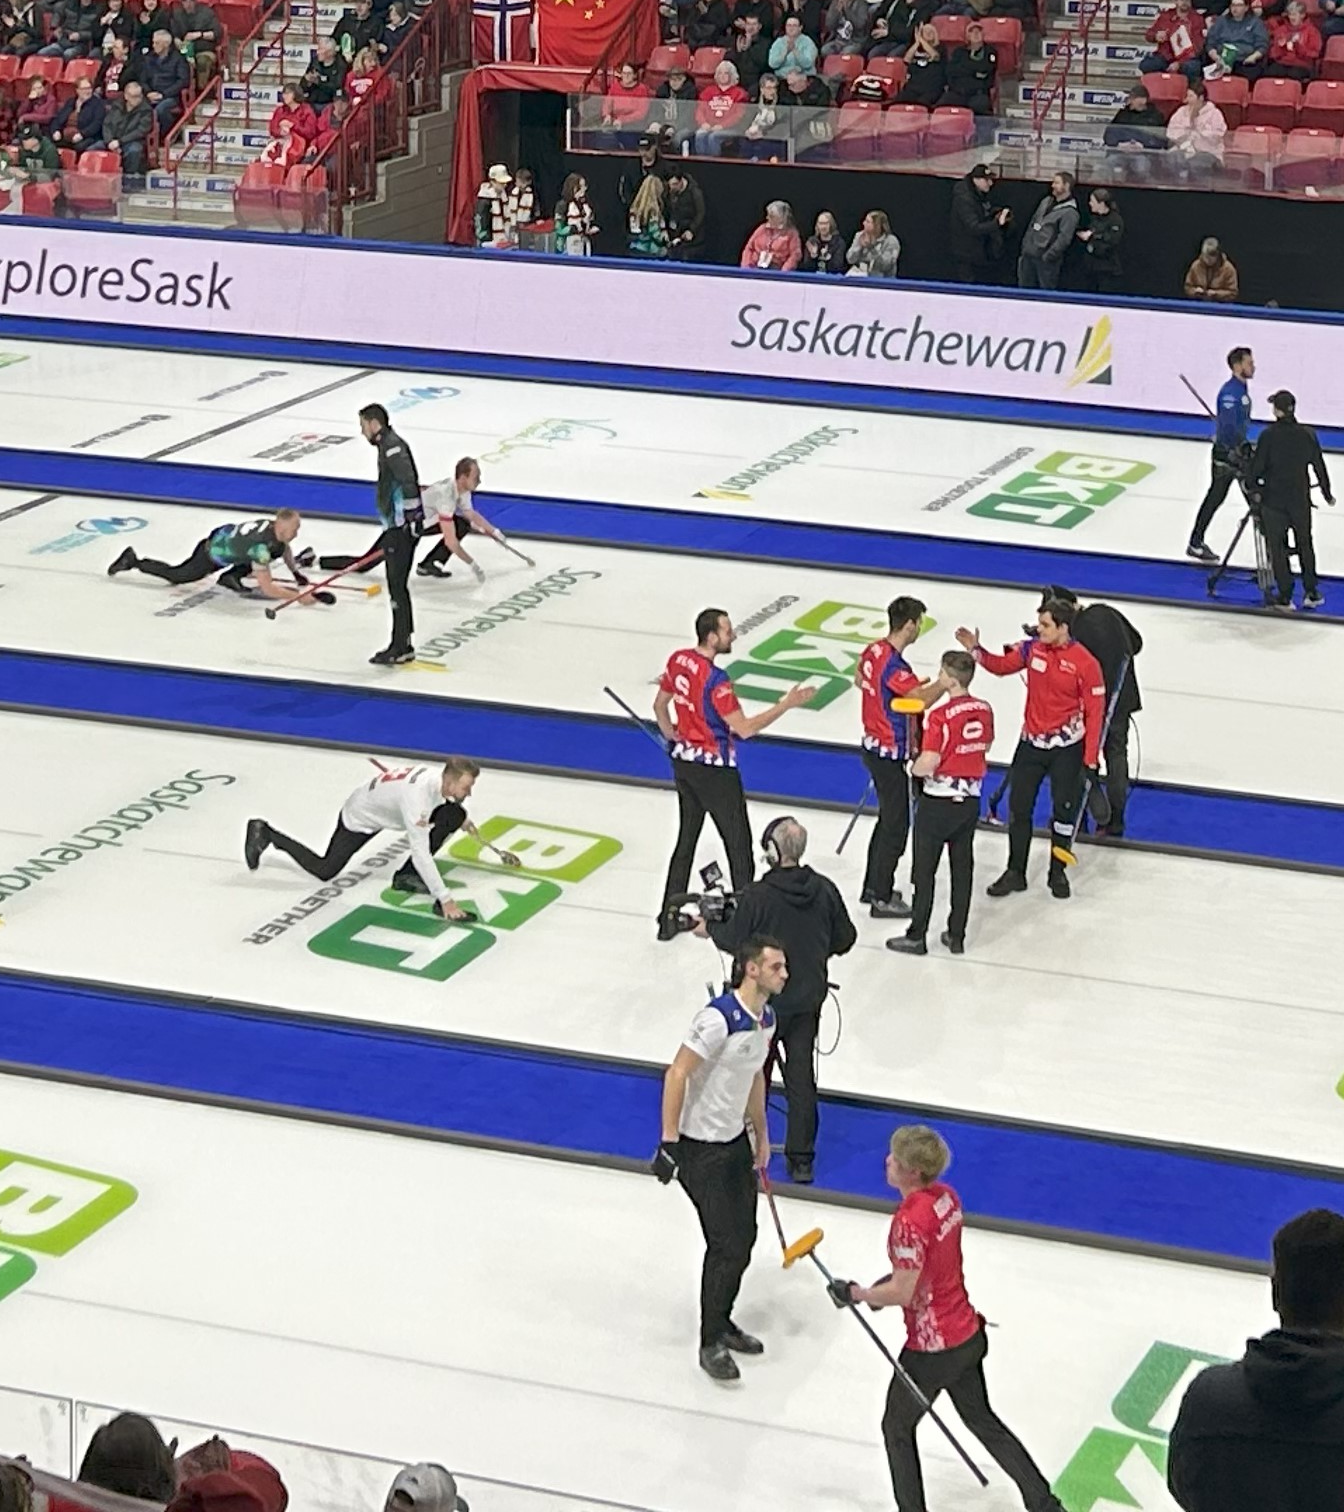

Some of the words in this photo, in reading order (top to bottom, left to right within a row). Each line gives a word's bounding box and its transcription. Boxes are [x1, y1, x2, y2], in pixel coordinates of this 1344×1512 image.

[731, 304, 1067, 375] Saskatchewan
[719, 424, 860, 491] Saskatchewan
[922, 474, 989, 512] TOGETHER
[978, 446, 1036, 477] GROWING
[981, 452, 1143, 527] BKT
[417, 566, 603, 660] Saskatchewan
[249, 856, 375, 946] TOGETHER
